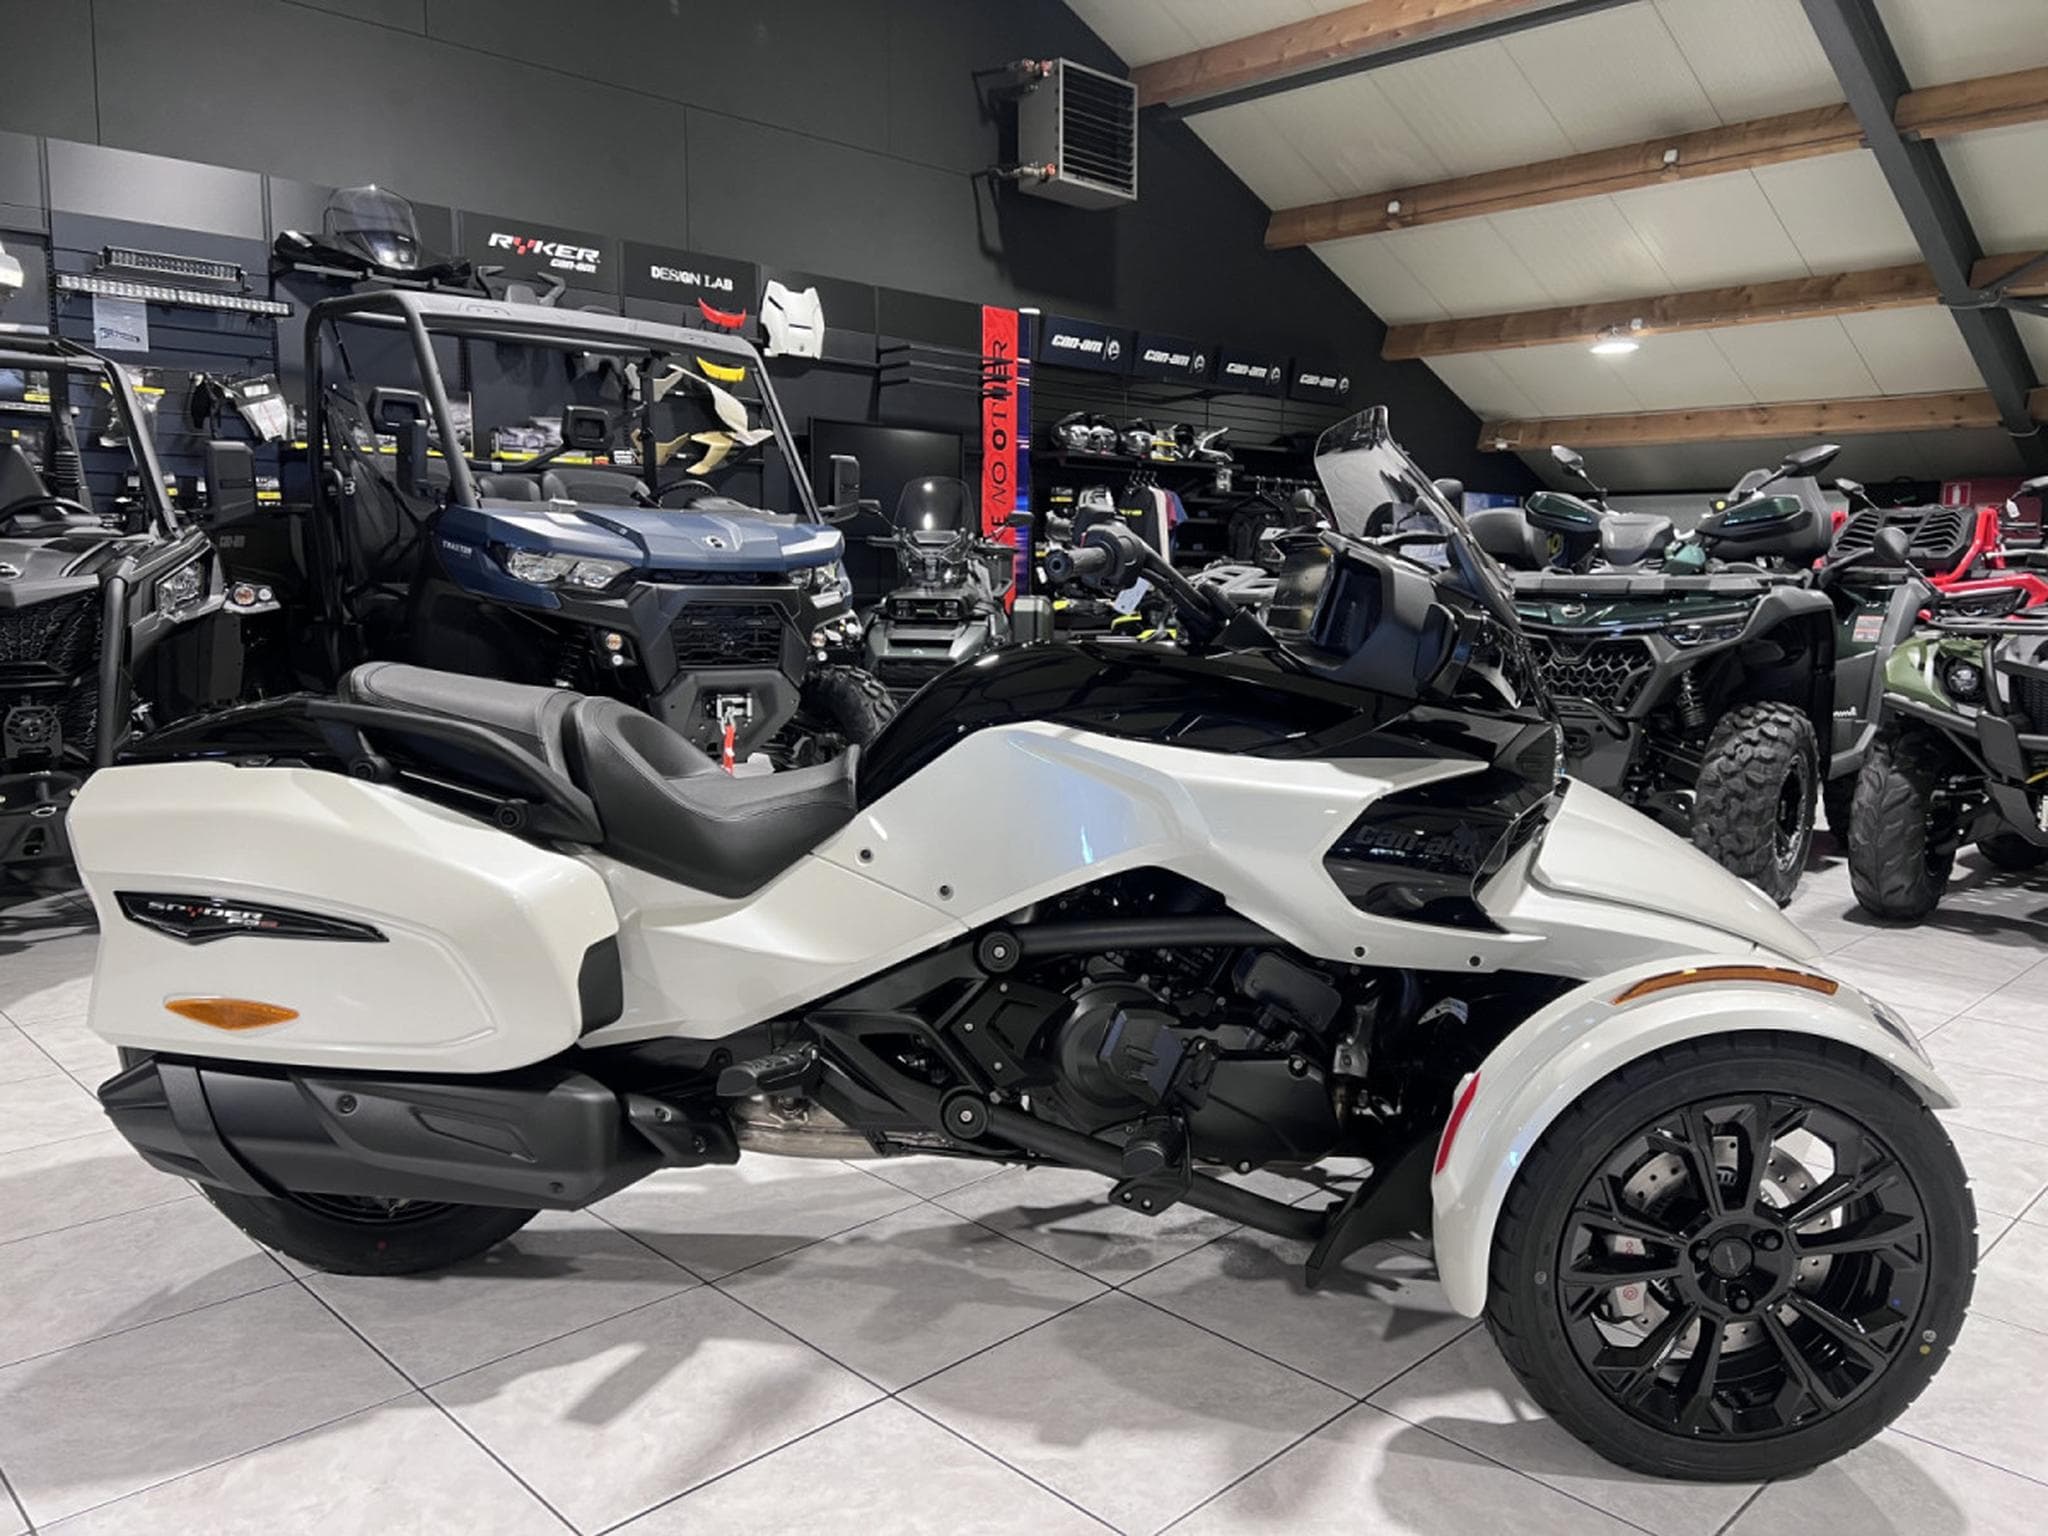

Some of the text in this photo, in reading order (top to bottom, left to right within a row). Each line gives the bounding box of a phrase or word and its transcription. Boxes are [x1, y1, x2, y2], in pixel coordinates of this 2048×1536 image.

[488, 232, 599, 263] RYKER
[550, 258, 597, 274] can-am
[650, 265, 733, 292] DESIGN LAB
[1051, 334, 1103, 353] can-am
[1143, 349, 1190, 367] can-am
[1226, 362, 1268, 379] can-am
[1299, 373, 1338, 389] can-am
[991, 462, 1007, 504] NO
